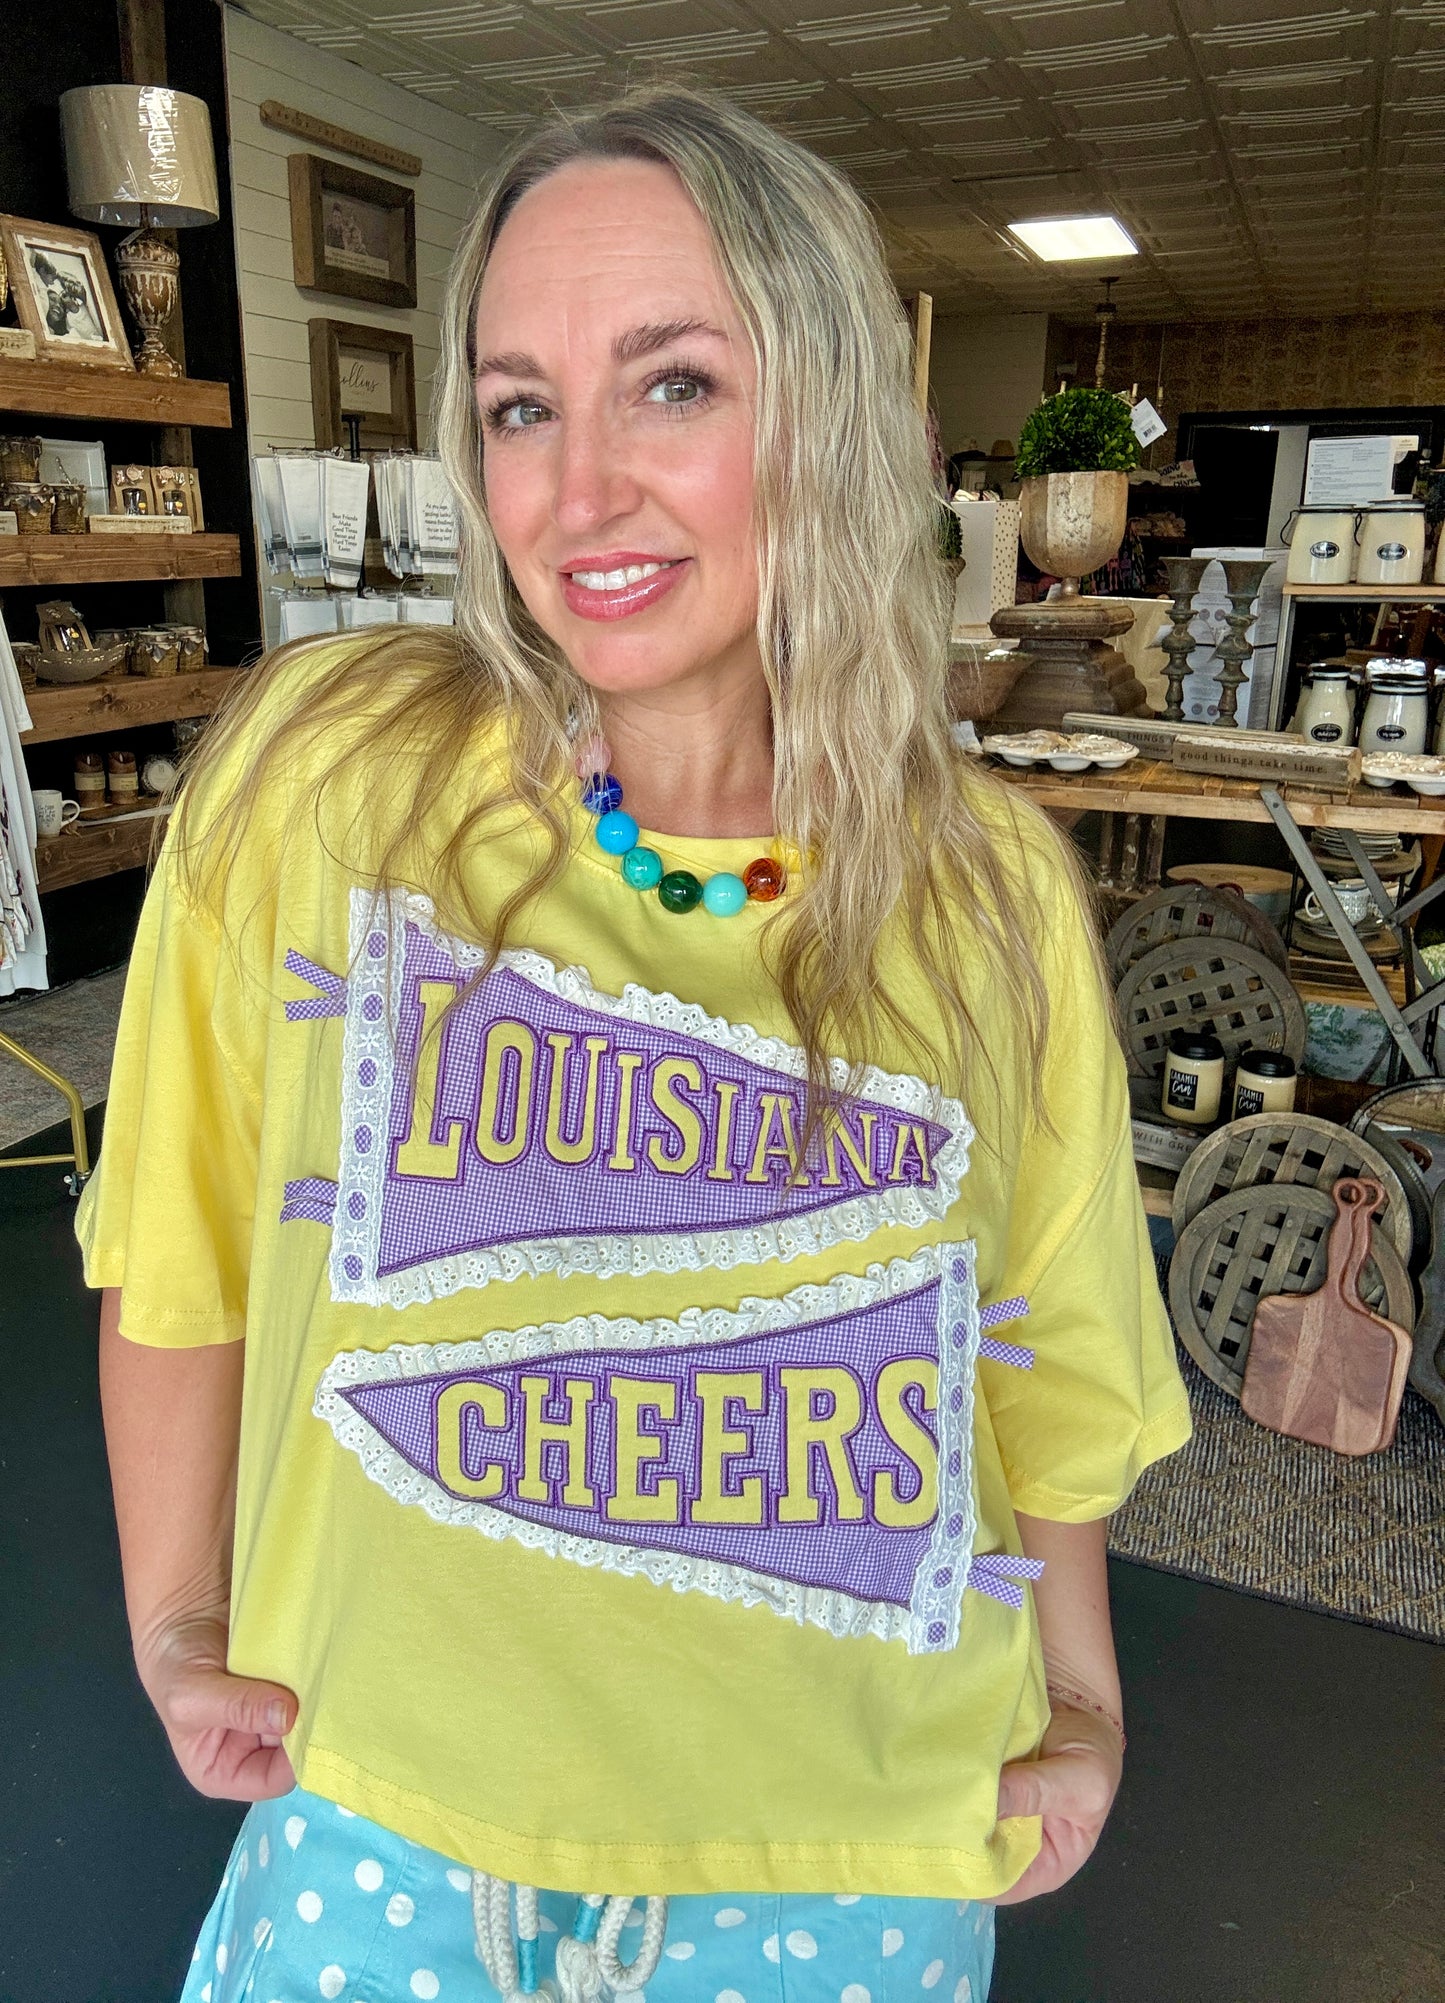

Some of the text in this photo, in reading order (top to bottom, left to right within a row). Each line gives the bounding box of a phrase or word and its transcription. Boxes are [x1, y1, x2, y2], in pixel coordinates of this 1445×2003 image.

[340, 361, 380, 393] ollins
[1071, 725, 1085, 734] DO
[1127, 731, 1165, 744] THINGS
[1180, 750, 1209, 762] good
[1214, 752, 1254, 768] things
[1260, 757, 1288, 770] take
[393, 975, 937, 1189] LOUISIANA
[1171, 1080, 1192, 1097] Corn
[1238, 1096, 1258, 1113] Corn
[1134, 1131, 1163, 1145] WITH
[432, 1353, 939, 1531] CHEERS
